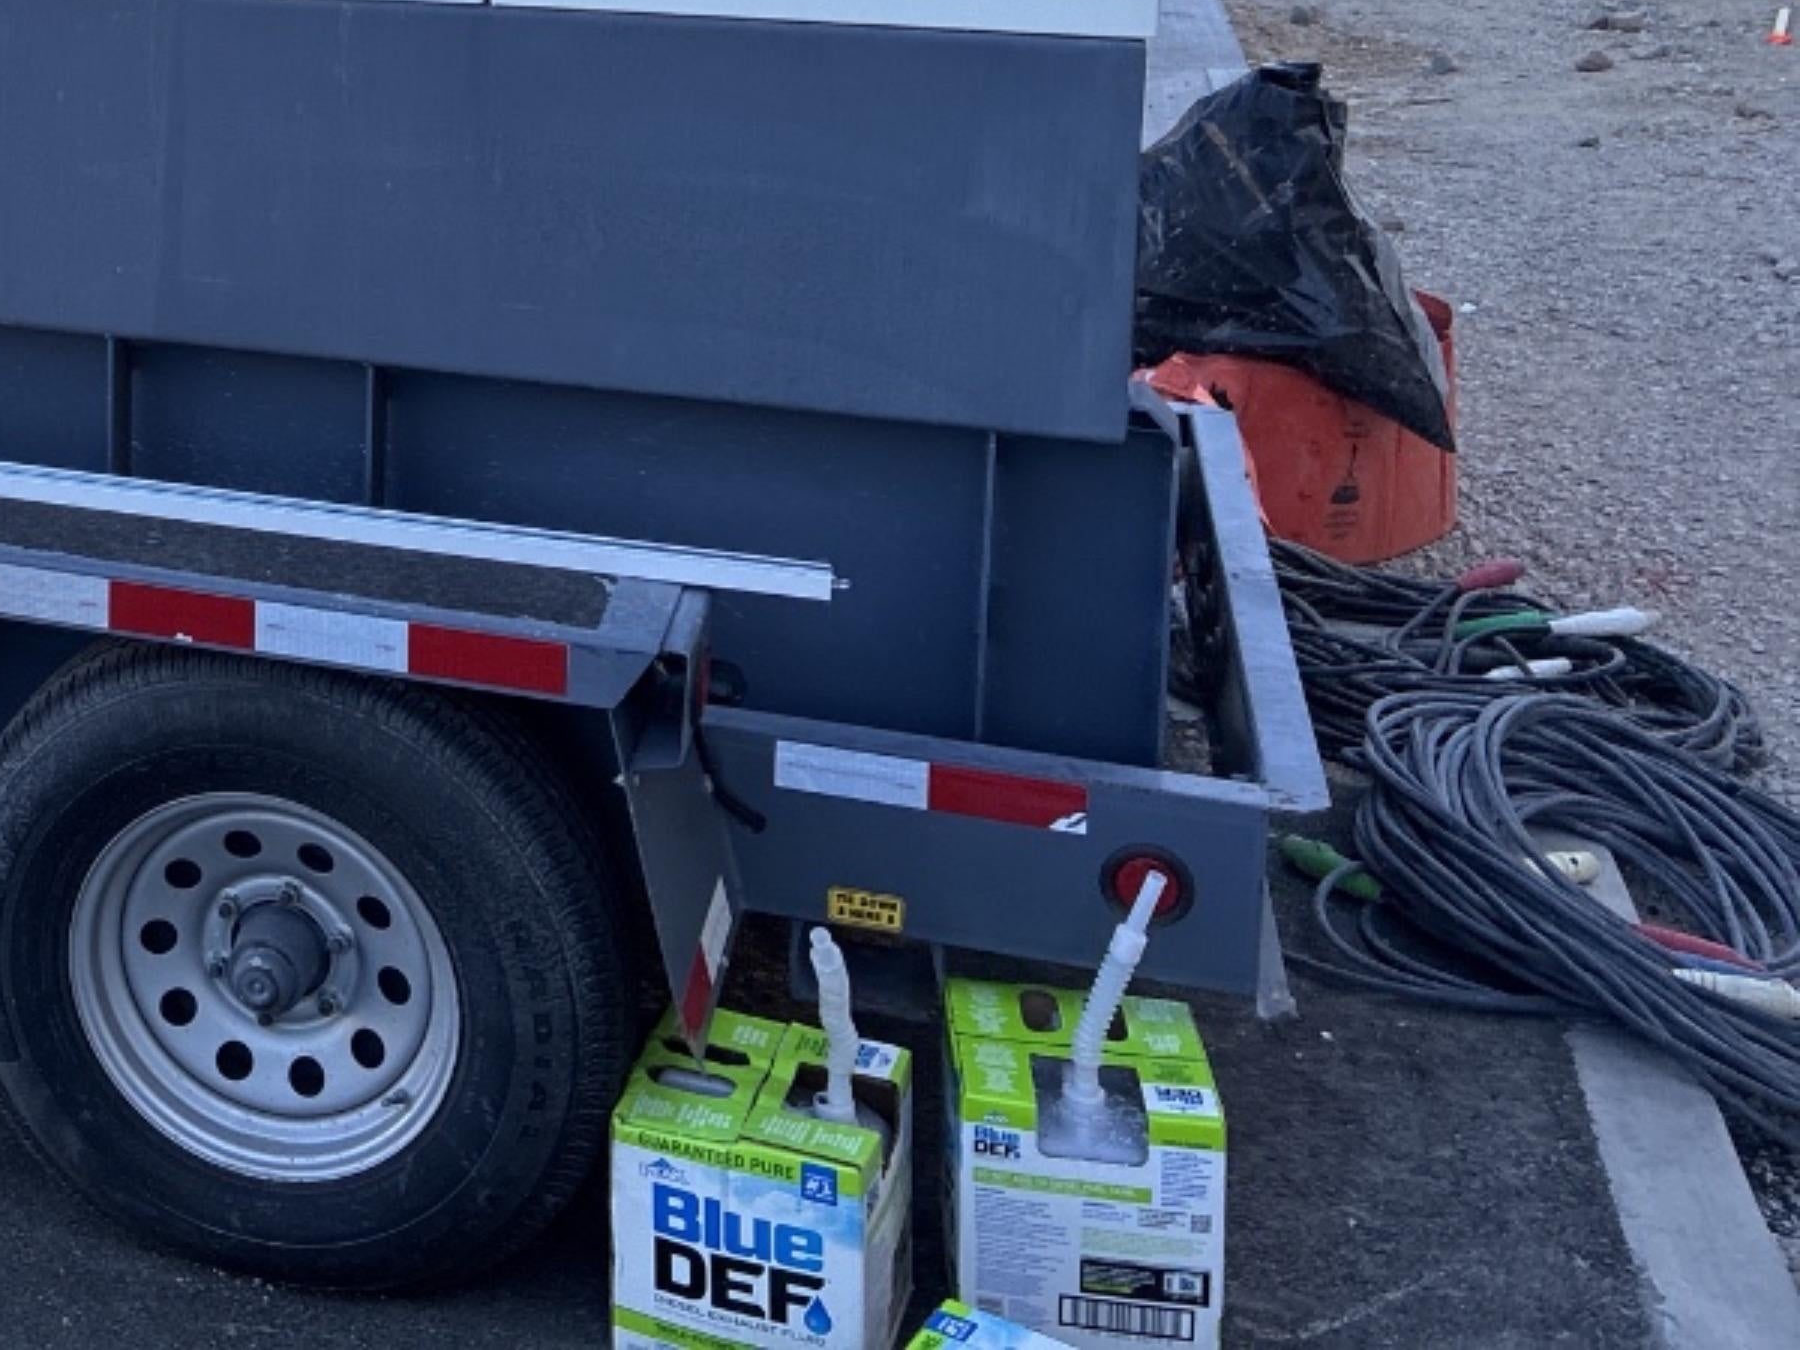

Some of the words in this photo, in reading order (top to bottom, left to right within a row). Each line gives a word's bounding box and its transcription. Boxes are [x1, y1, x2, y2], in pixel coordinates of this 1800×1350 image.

[639, 1132, 745, 1169] GUARANTEED
[750, 1156, 796, 1181] PURE
[653, 1181, 824, 1273] Blue
[654, 1236, 828, 1325] DEF
